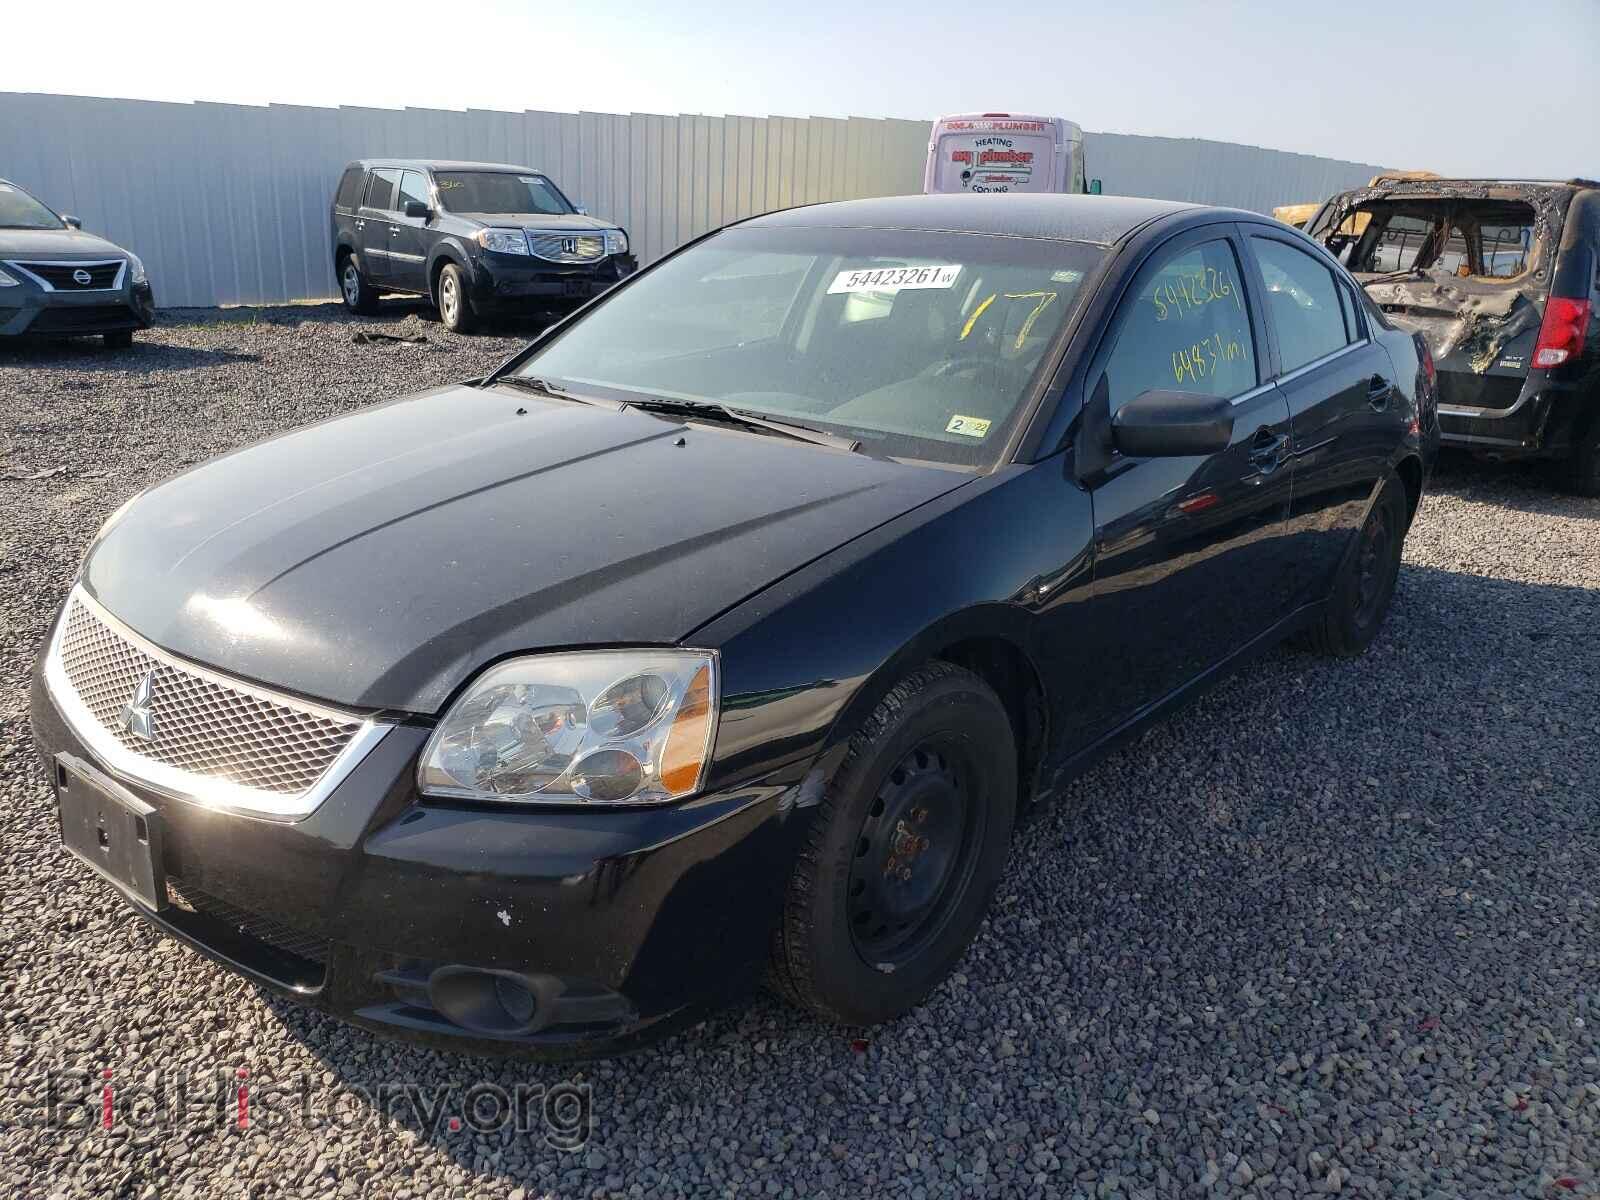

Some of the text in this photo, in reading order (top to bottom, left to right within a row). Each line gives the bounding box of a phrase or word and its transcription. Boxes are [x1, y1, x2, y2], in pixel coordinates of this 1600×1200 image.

[975, 138, 1013, 148] HEATING
[952, 149, 1033, 165] my plumber
[952, 419, 964, 430] 2
